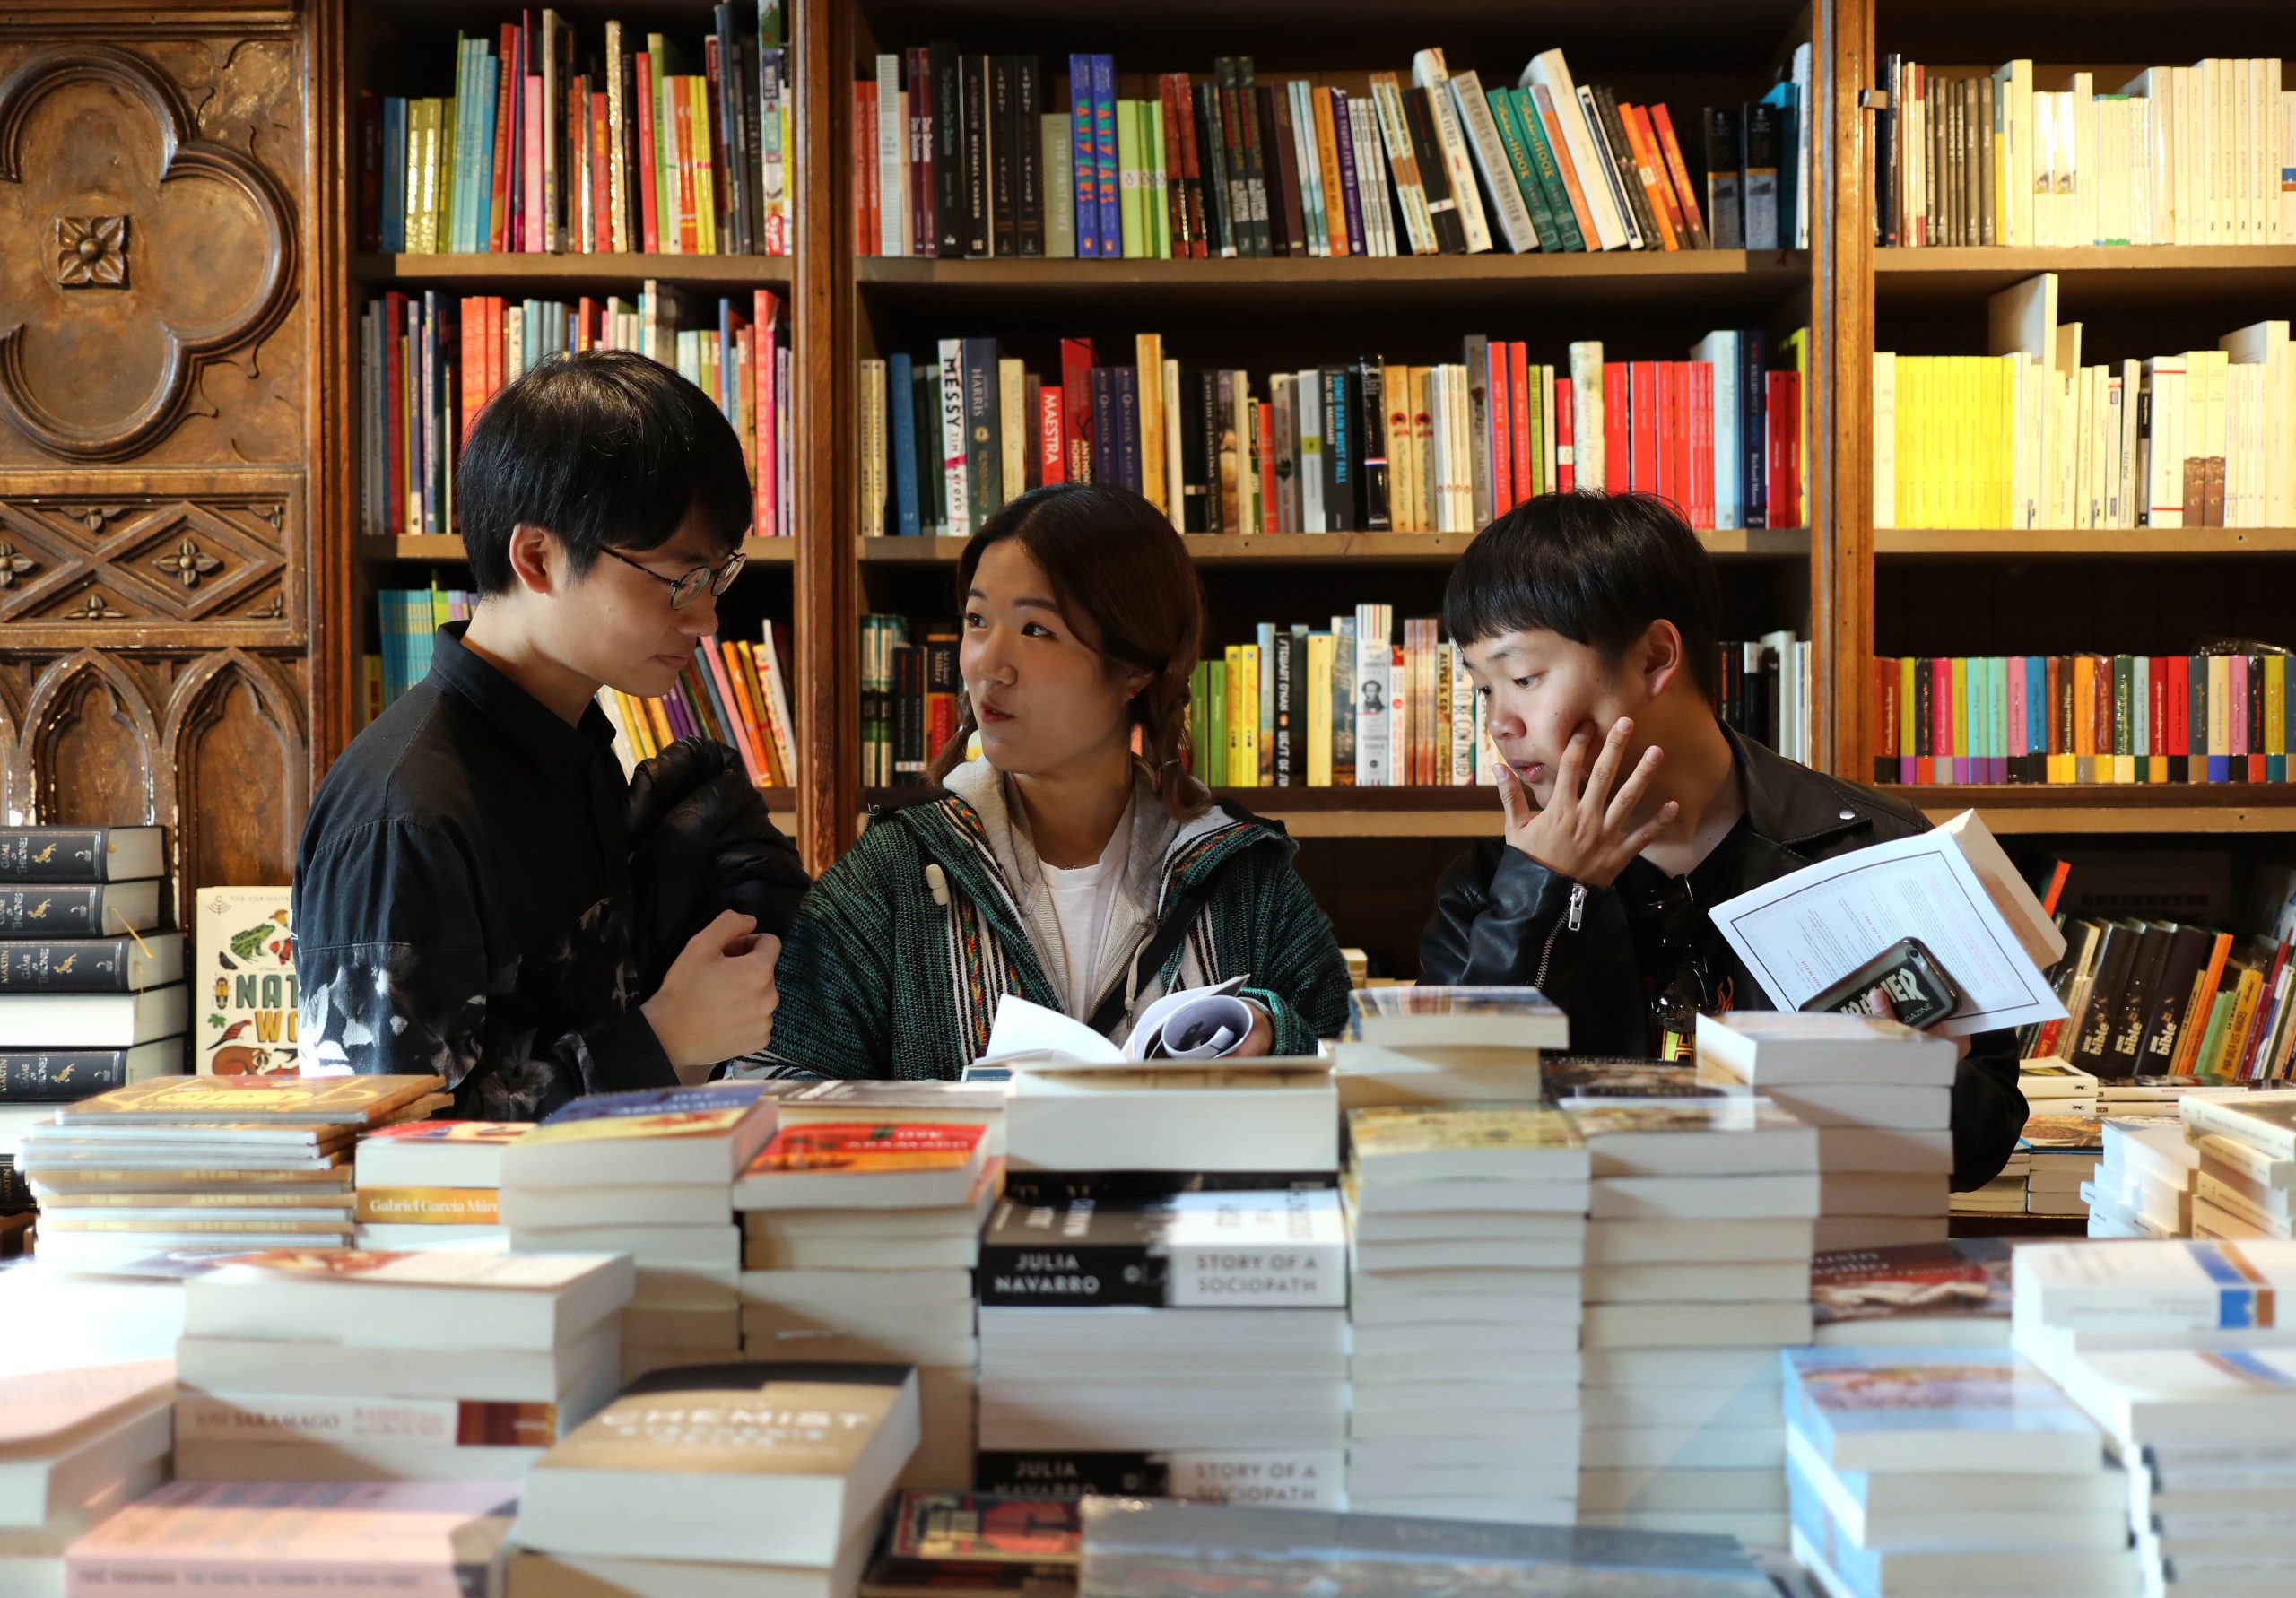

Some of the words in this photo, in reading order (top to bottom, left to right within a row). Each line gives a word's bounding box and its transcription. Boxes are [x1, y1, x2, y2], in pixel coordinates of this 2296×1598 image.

[1076, 98, 1091, 152] VANITY
[1098, 100, 1112, 155] VANITY
[1467, 98, 1491, 140] HEROES
[1493, 170, 1524, 224] FRONTIER
[1511, 142, 1531, 180] HOOK
[1533, 142, 1555, 180] HOOK
[1721, 341, 1733, 380] Javier
[944, 358, 961, 428] MESSY
[972, 368, 984, 417] HARRIS
[1334, 376, 1344, 403] SOME
[1515, 381, 1523, 401] HOT
[1044, 395, 1060, 465] MAESTRA
[1326, 406, 1335, 445] KNAUSGAARD
[1335, 405, 1344, 429] RAIN
[951, 432, 960, 452] TIM
[1335, 431, 1345, 459] MUST
[1497, 430, 1505, 470] DEBORAH
[1518, 430, 1526, 469] DEBORAH
[1336, 461, 1347, 483] FALL
[1751, 453, 1760, 481] Richard
[951, 458, 961, 511] HARFORD
[935, 652, 943, 682] Miller
[942, 648, 951, 685] Arthur
[1276, 639, 1290, 682] STEWART
[1280, 684, 1290, 711] O'NAN
[1454, 690, 1473, 700] TO
[1454, 705, 1472, 716] BE
[1279, 731, 1290, 755] WEST
[1454, 721, 1474, 777] CONTINUED
[1279, 759, 1290, 772] OF
[1, 843, 10, 869] GAME
[17, 837, 28, 874] THRONES
[14, 892, 23, 930] THRONES
[22, 954, 31, 979] GAME
[39, 948, 49, 985] THRONES
[2089, 1020, 2112, 1056] bible
[2113, 1033, 2126, 1053] une
[2122, 1020, 2144, 1055] bible
[2146, 1033, 2161, 1053] une
[2156, 1020, 2179, 1056] bible
[21, 1063, 30, 1089] GAME
[38, 1056, 48, 1093] THRONES
[370, 1198, 420, 1212] Gabriel
[421, 1199, 464, 1212] García
[1016, 1252, 1080, 1270] JULIA
[1196, 1255, 1264, 1270] STORY
[1271, 1254, 1298, 1270] OF
[1303, 1255, 1318, 1270] A
[995, 1275, 1101, 1295] NAVARRO
[1197, 1277, 1318, 1293] SOCIOPATH
[233, 1413, 340, 1429] SARAMAGO
[600, 1408, 871, 1429] CHEMIST
[1016, 1461, 1077, 1478] JULIA
[1196, 1462, 1262, 1479] STORY
[1268, 1462, 1296, 1479] OF
[1302, 1462, 1318, 1479] A
[1196, 1485, 1318, 1502] SOCIOPATH
